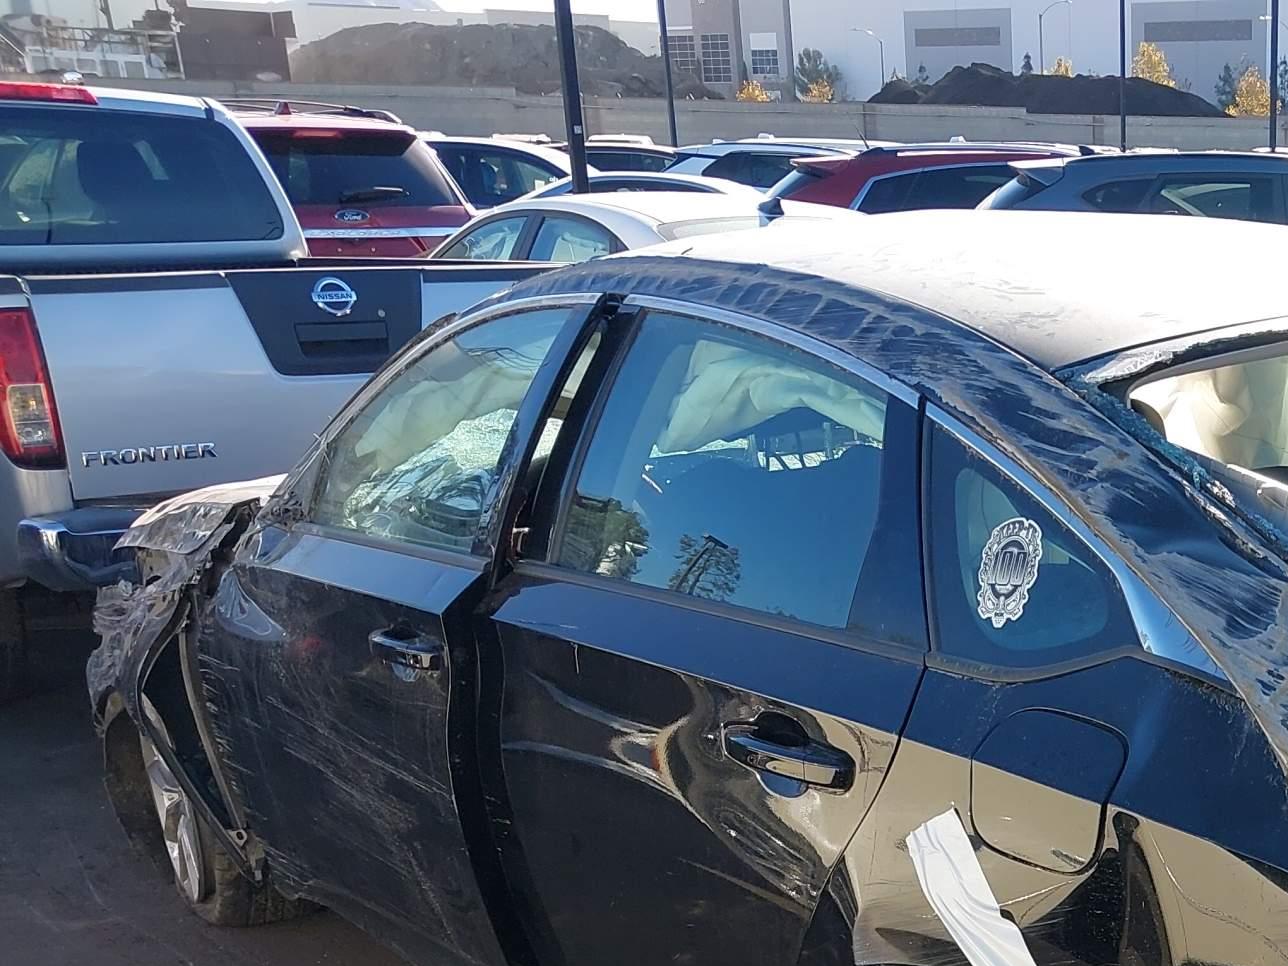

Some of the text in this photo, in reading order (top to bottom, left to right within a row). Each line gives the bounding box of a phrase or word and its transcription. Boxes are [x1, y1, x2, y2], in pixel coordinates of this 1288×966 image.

[343, 210, 362, 221] Ford
[317, 292, 353, 301] NISSAN
[81, 442, 218, 468] FRONTIER
[987, 548, 1029, 586] 100
